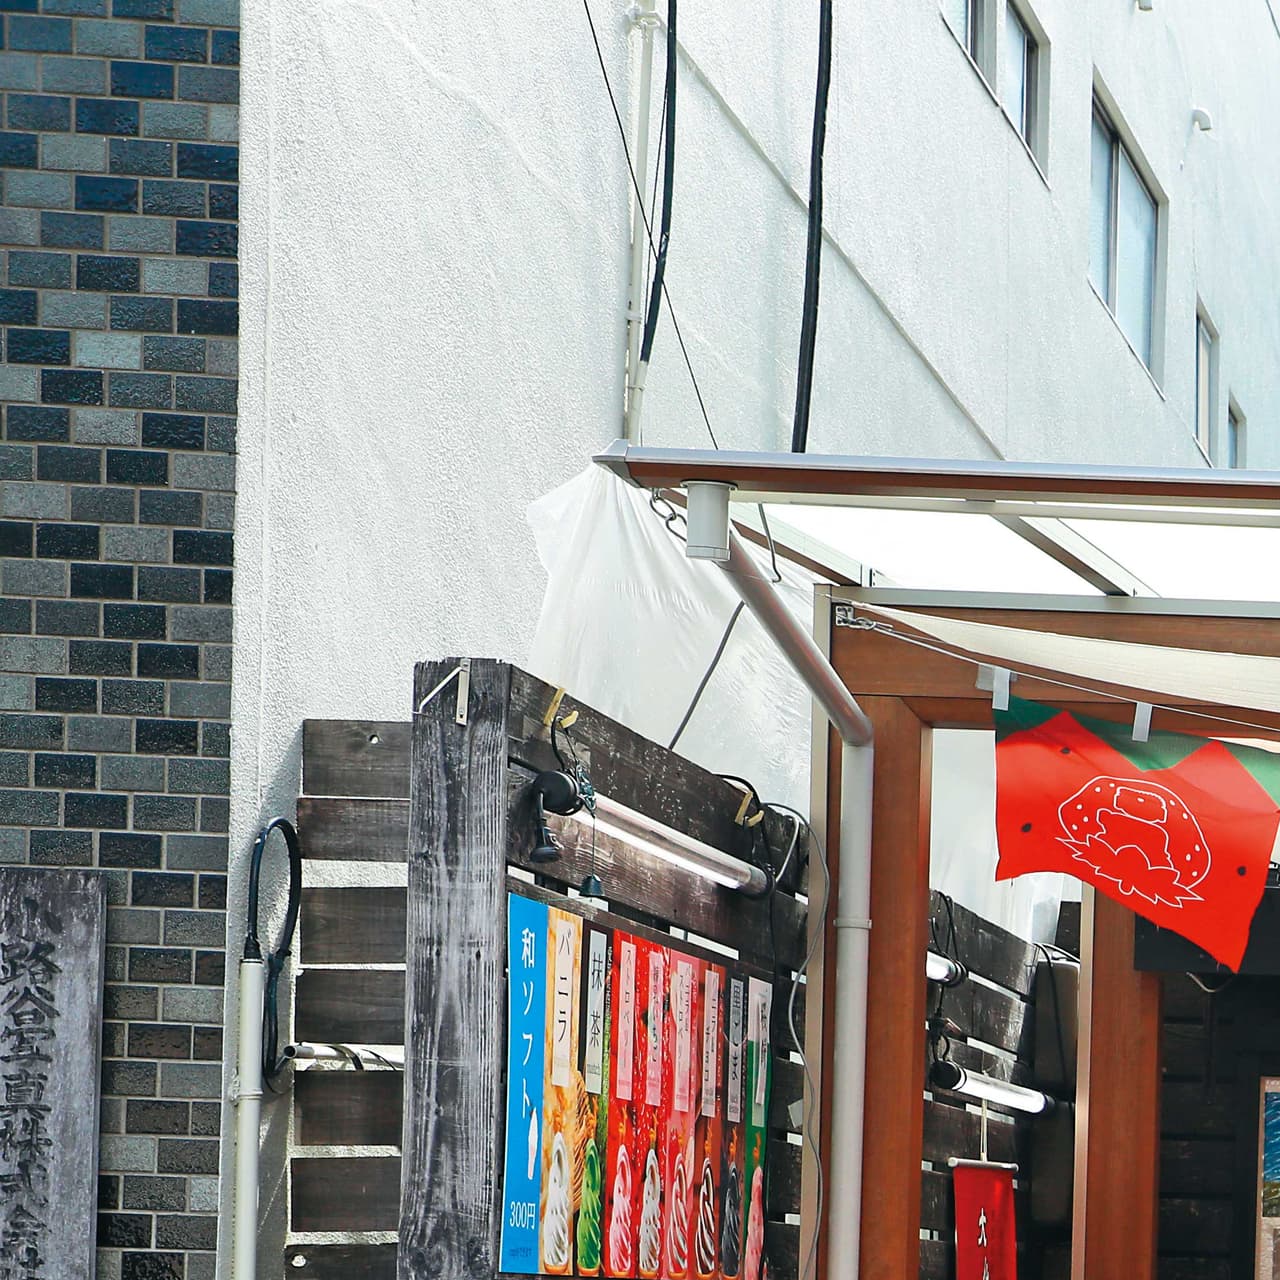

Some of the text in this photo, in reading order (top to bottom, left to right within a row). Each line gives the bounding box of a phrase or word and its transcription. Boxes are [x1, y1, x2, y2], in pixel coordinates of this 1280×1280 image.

[521, 927, 536, 1119] 和ソフト
[558, 928, 573, 1043] バニラ
[589, 952, 604, 1048] 抹茶
[510, 1201, 536, 1230] 300円
